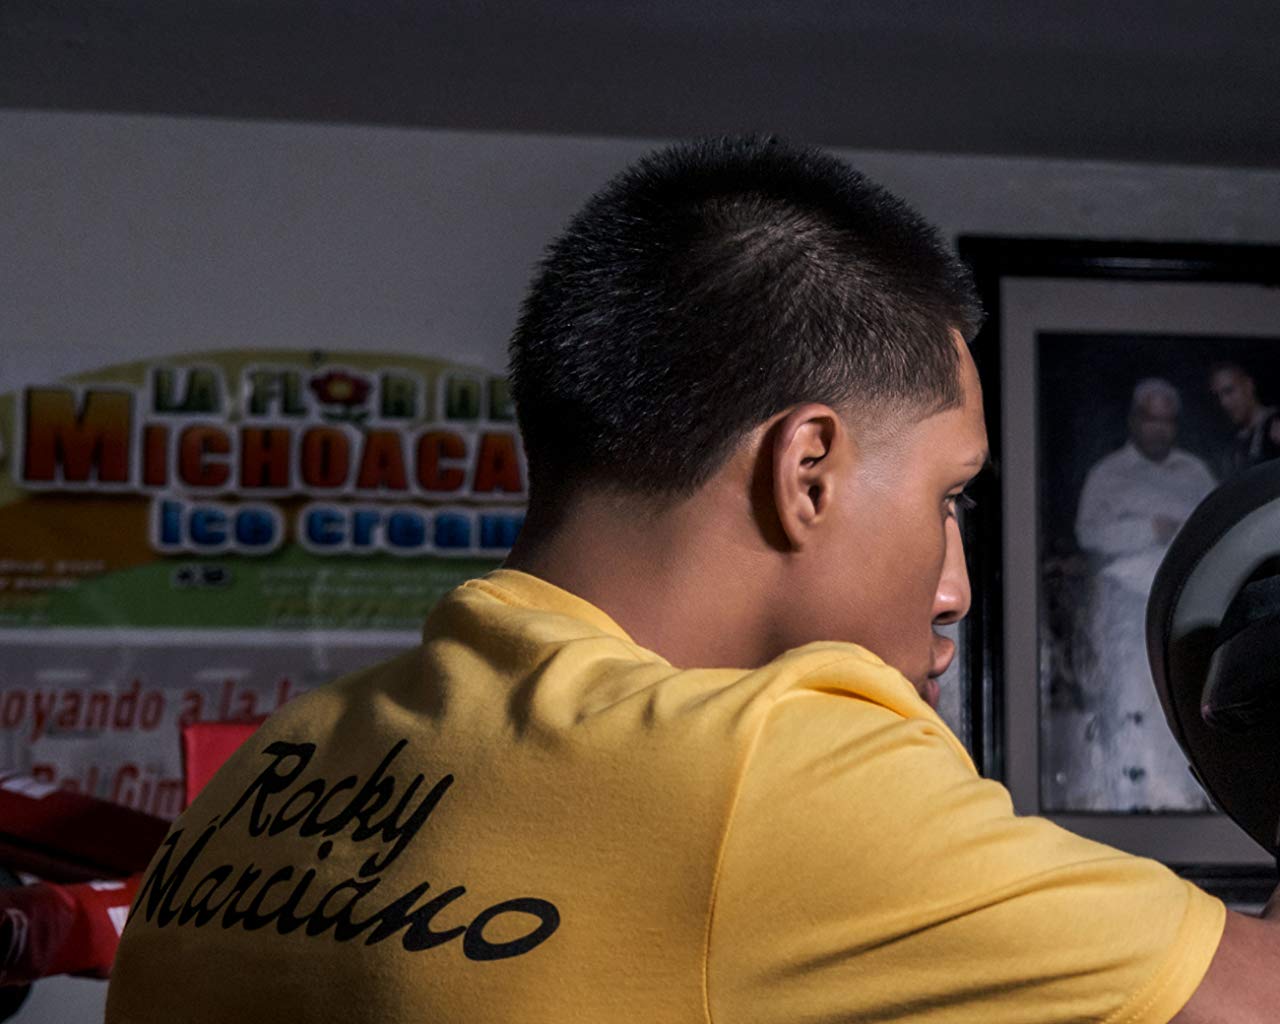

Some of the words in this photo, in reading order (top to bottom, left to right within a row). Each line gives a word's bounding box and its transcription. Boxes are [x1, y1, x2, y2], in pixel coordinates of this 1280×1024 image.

[22, 388, 524, 493] MICHOACA
[154, 366, 219, 414] LA
[1, 680, 167, 742] oyando
[220, 739, 454, 877] Rocky
[126, 815, 560, 961] Marciano
